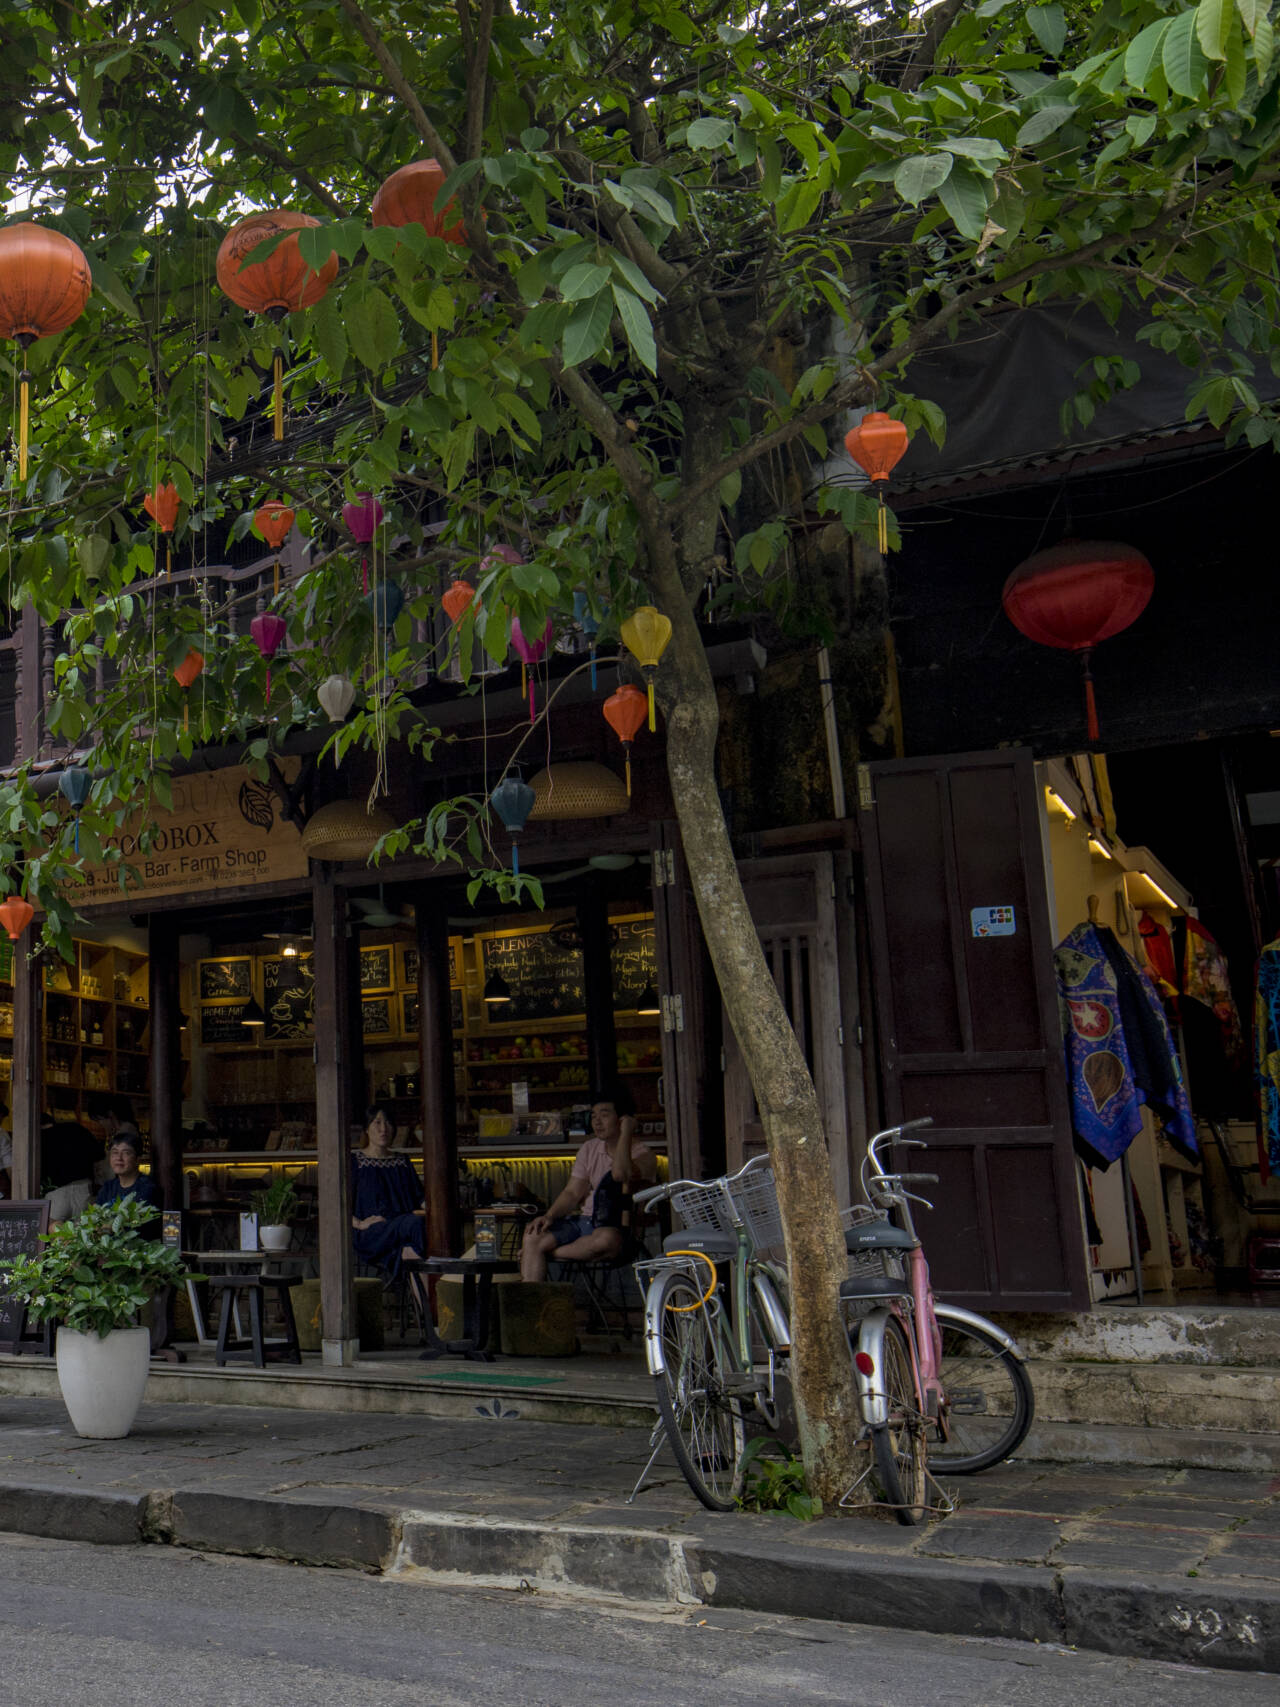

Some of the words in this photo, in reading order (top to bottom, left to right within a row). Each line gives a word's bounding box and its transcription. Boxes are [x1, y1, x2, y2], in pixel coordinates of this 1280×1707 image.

[103, 865, 141, 886] Juc
[145, 862, 170, 878] Bar
[180, 854, 220, 874] Farm
[225, 848, 266, 868] Shop
